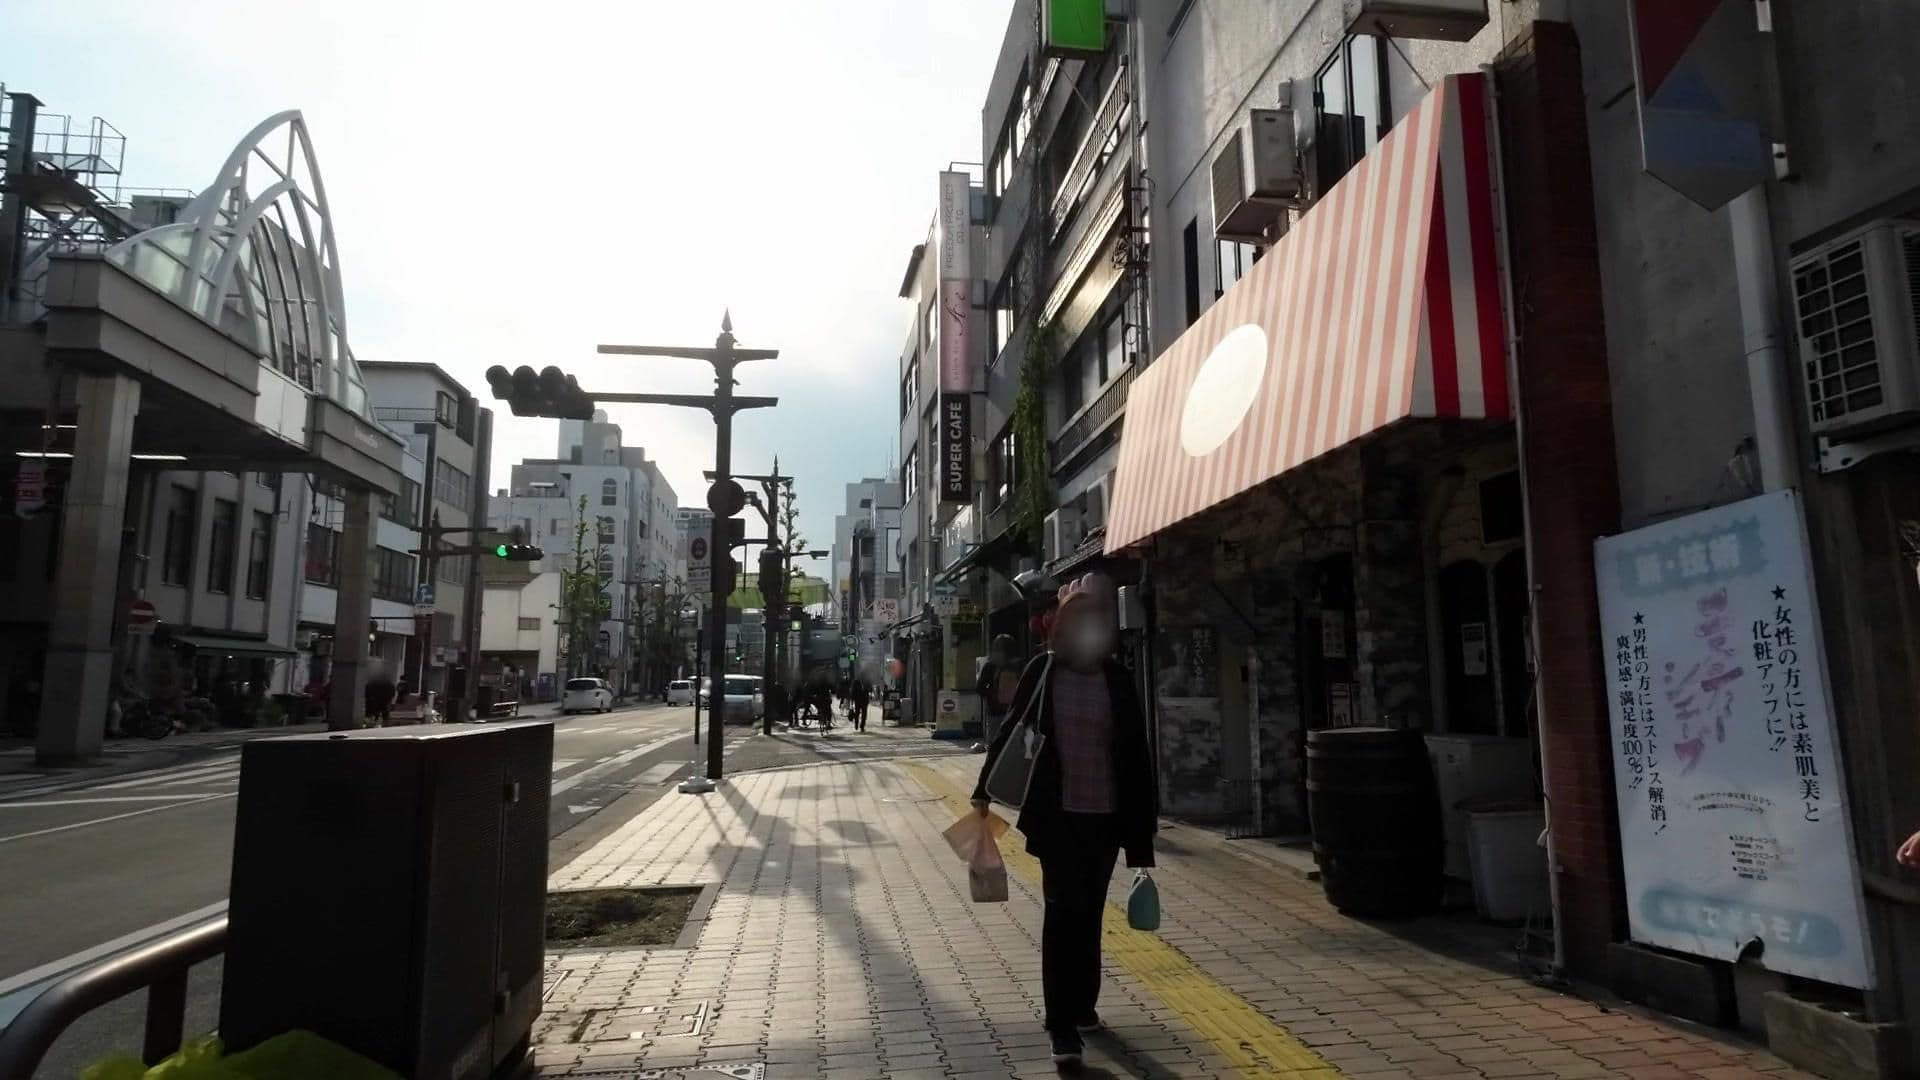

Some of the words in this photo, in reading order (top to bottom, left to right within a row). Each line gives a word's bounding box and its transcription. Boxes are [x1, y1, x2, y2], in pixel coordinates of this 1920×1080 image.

[950, 443, 962, 492] SUPER
[1775, 605, 1820, 823] 女性の方には素肌美と
